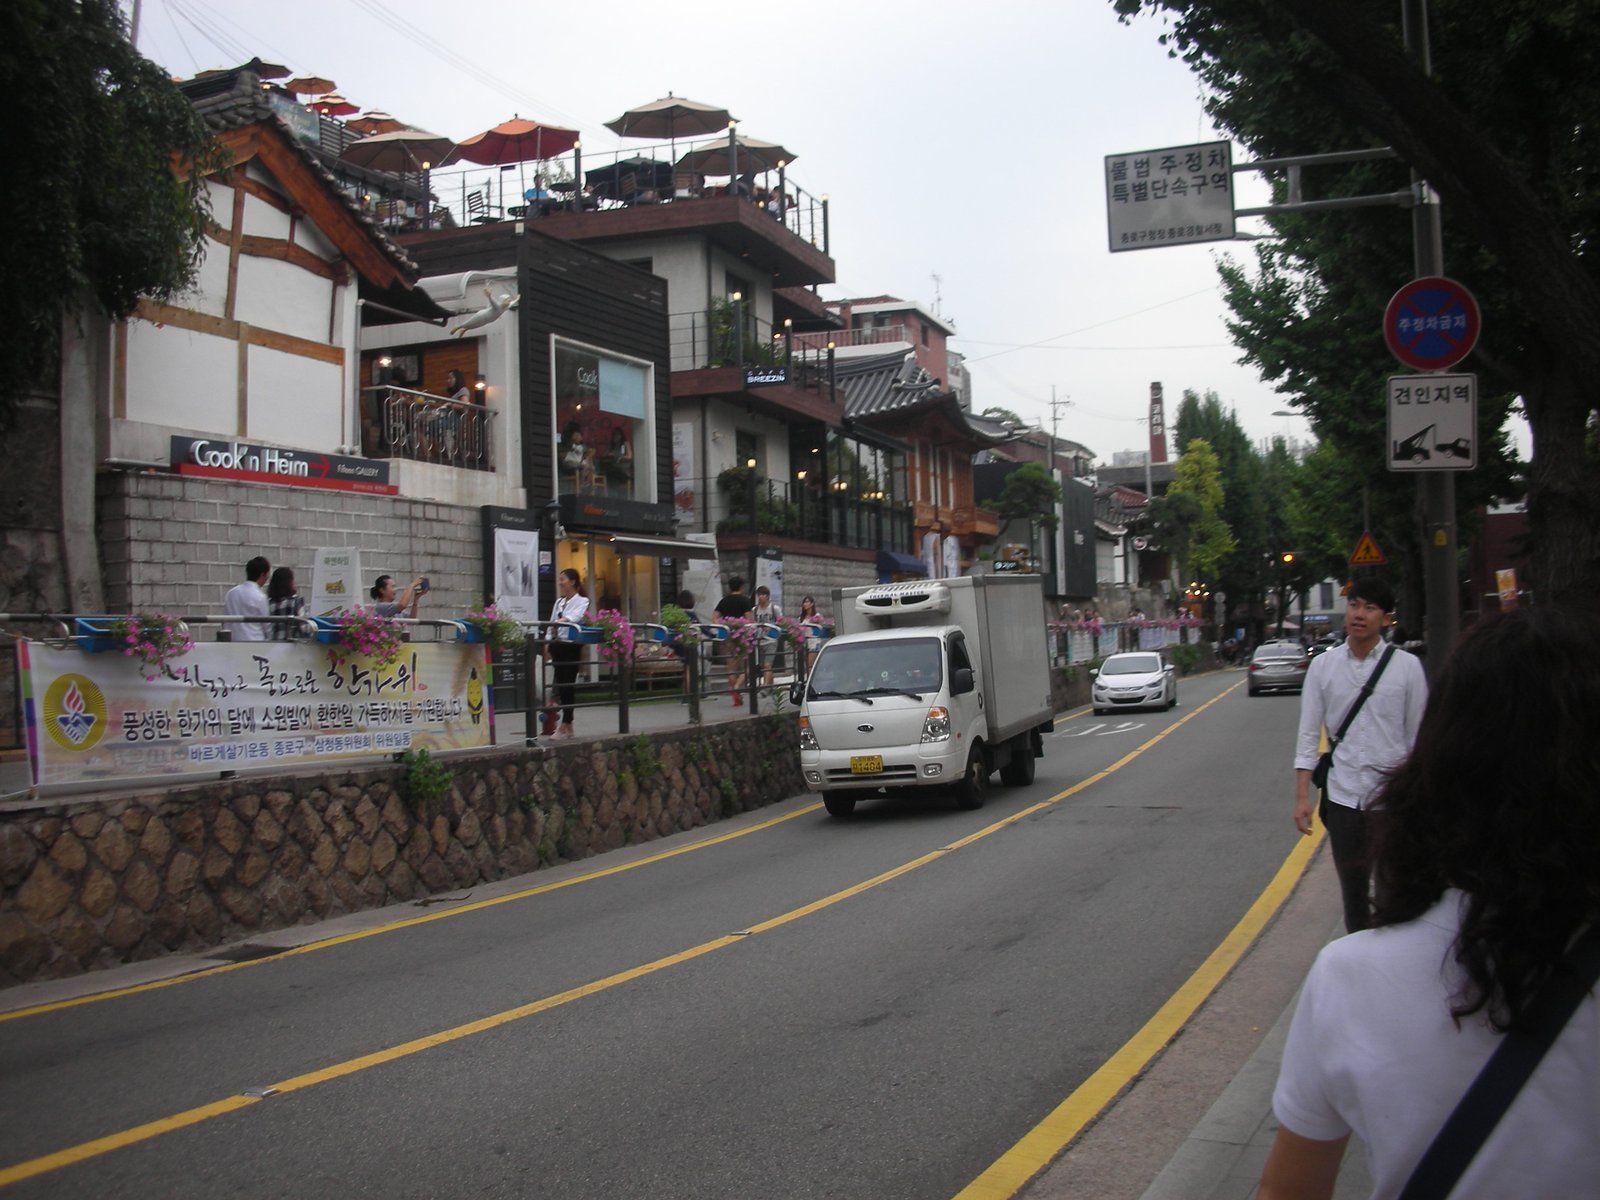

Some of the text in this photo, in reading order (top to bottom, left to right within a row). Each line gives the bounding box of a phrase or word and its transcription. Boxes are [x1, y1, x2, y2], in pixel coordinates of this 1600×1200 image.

[1111, 157, 1150, 181] 불법
[1112, 171, 1229, 204] 특별단속구역
[1398, 314, 1467, 333] 주정차금지
[1395, 384, 1470, 405] 견인지역
[262, 448, 309, 477] Heim
[252, 654, 320, 697] 풍요로운
[327, 651, 418, 697] 한가위
[123, 709, 171, 741] 풍성한
[177, 706, 222, 738] 한가위
[227, 705, 256, 735] 달에
[261, 703, 313, 732] 소원빌어
[357, 700, 413, 727] 가득하시길
[191, 731, 411, 761] 바르게살기운동 종로구 삼청동위원회 위원일동
